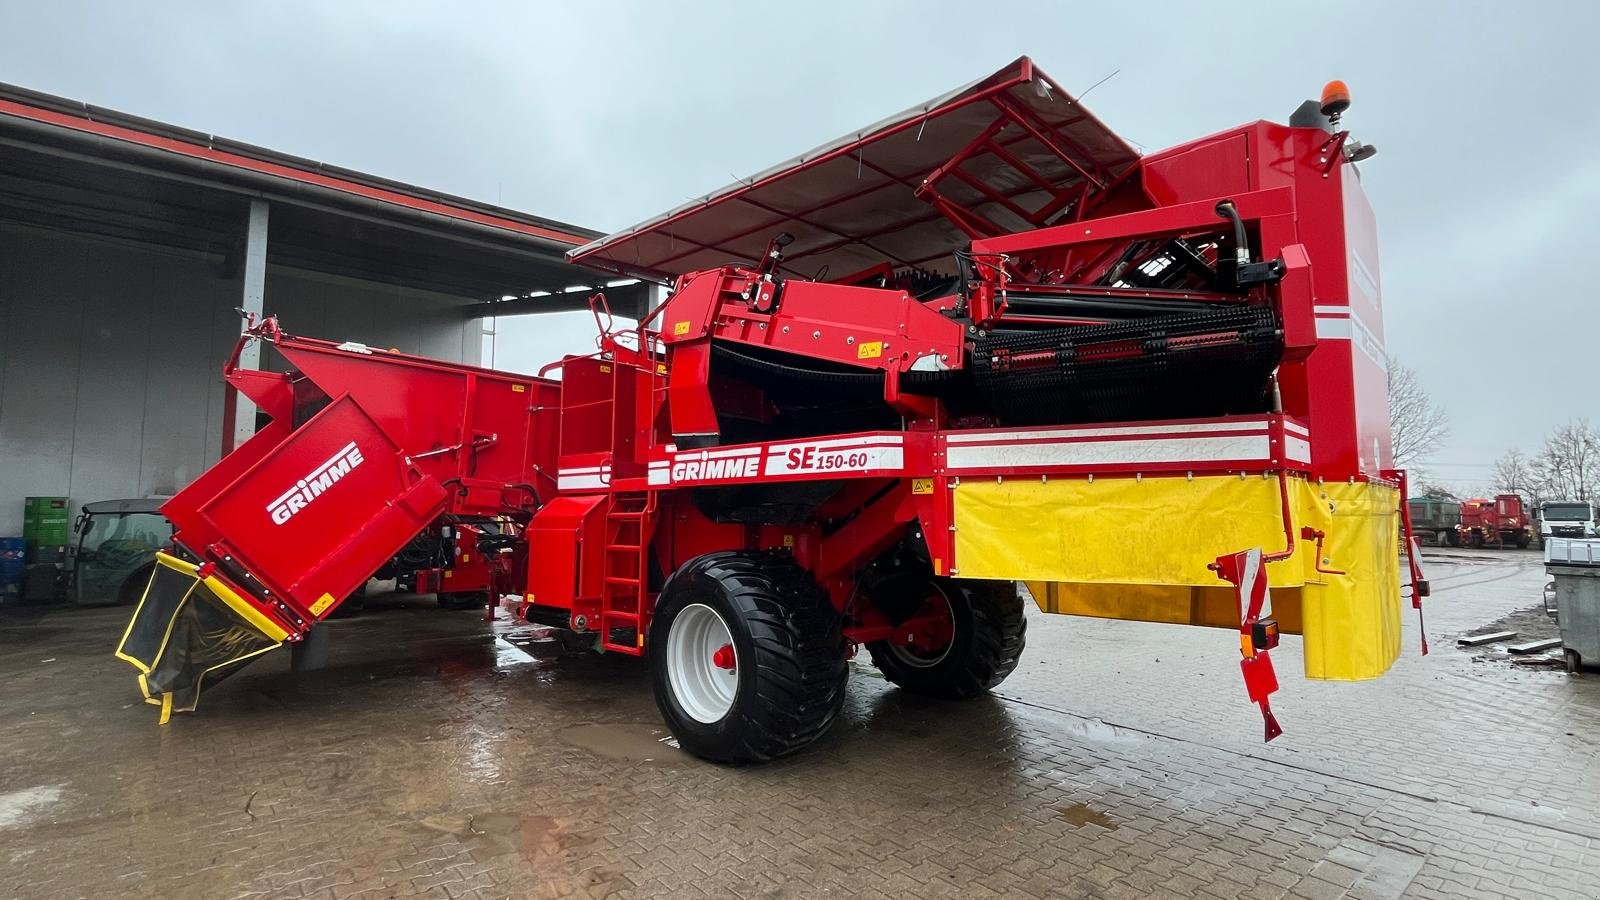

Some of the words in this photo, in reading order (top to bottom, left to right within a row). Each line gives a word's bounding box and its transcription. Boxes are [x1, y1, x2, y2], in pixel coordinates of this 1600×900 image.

[672, 451, 760, 481] GRIMME
[786, 447, 816, 470] SE
[816, 453, 867, 470] 150-60
[269, 443, 365, 526] GRIMME
